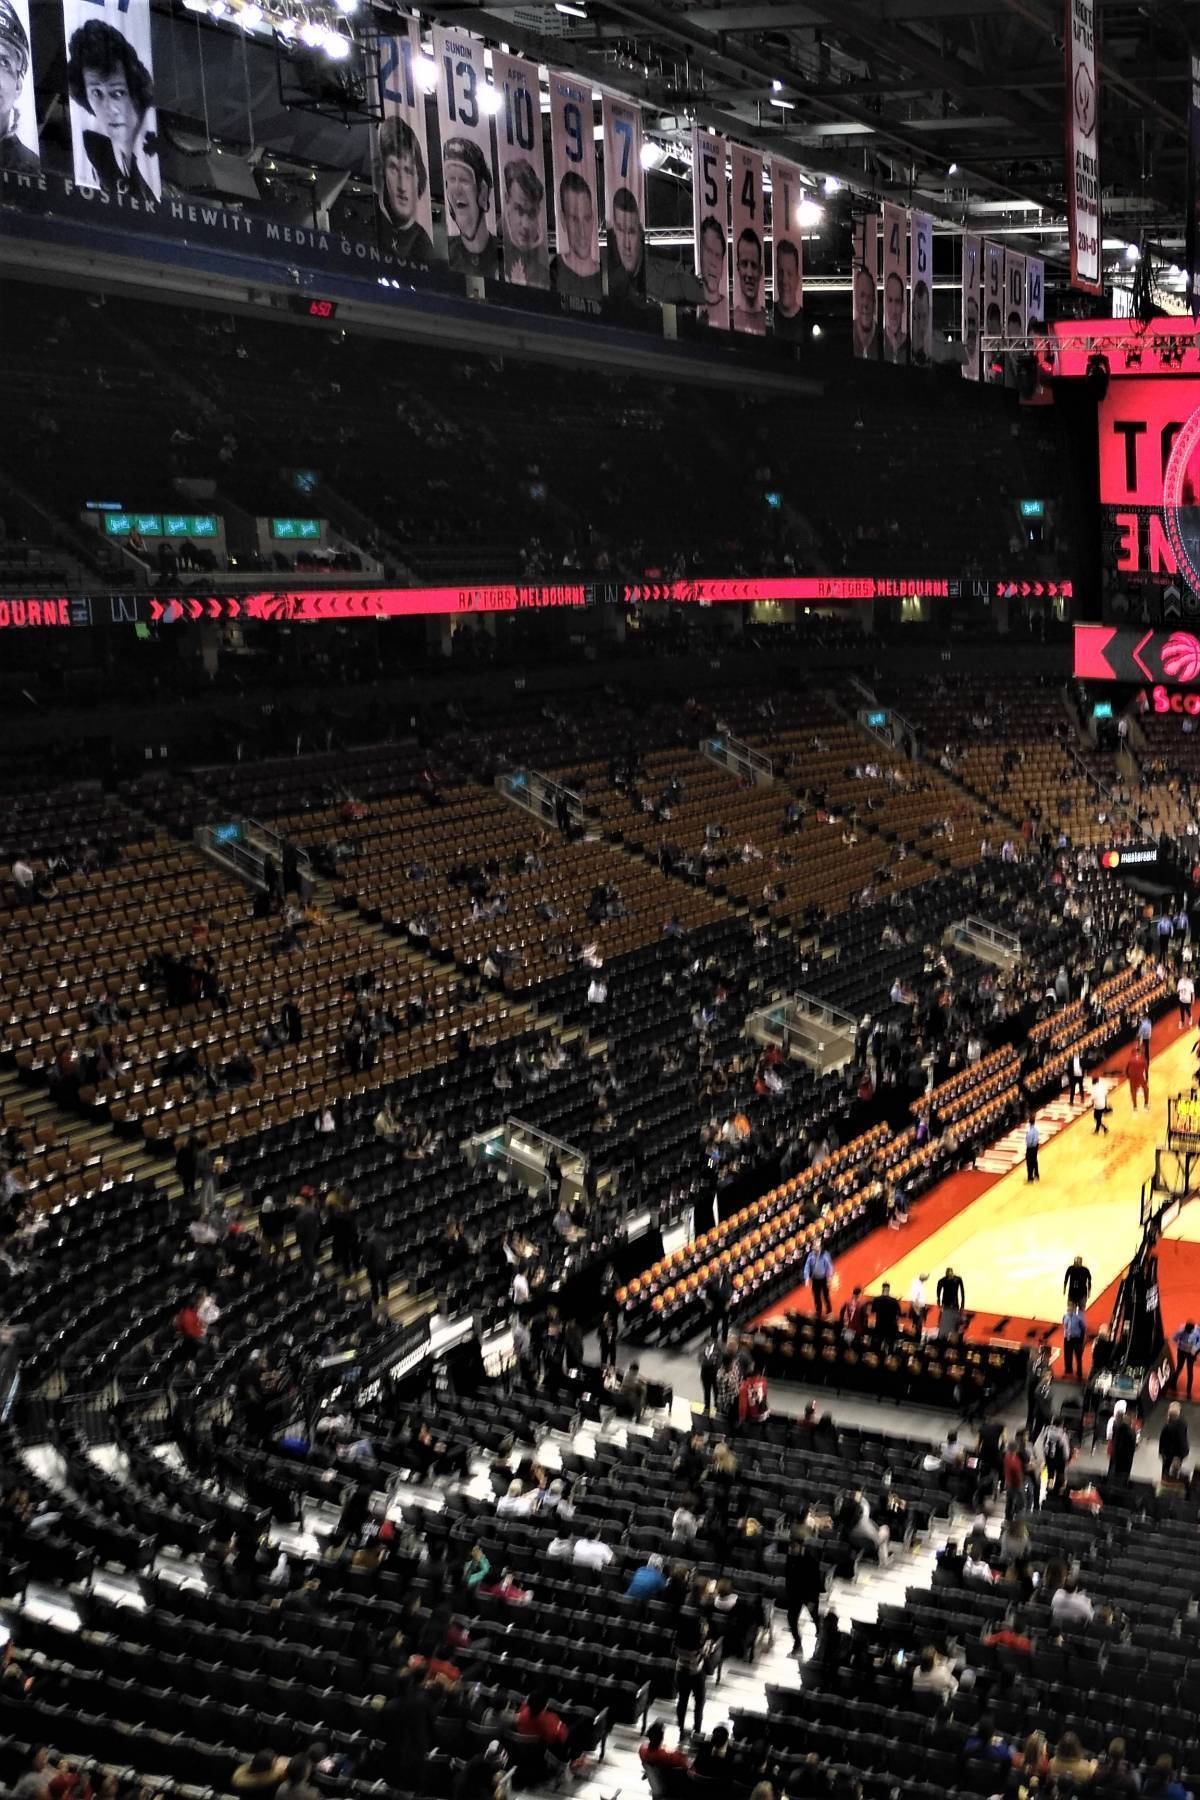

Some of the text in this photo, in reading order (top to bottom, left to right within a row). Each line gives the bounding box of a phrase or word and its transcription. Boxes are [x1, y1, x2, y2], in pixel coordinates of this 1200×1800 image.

[377, 36, 415, 108] 21
[444, 39, 473, 60] SUNDIN
[442, 55, 480, 128] 13
[502, 80, 536, 151] 10
[564, 102, 583, 163] 9
[614, 119, 634, 178] 7
[703, 153, 718, 208] 5
[741, 169, 756, 220] 4
[64, 179, 156, 214] FOSTER
[170, 202, 252, 233] HEWITT
[266, 222, 329, 251] MEDIA
[783, 182, 790, 231] 1
[890, 222, 901, 265] 4
[917, 231, 927, 273] 6
[1028, 271, 1041, 310] 14
[519, 585, 587, 608] MELBOURNE
[877, 578, 949, 597] MELBOURNE
